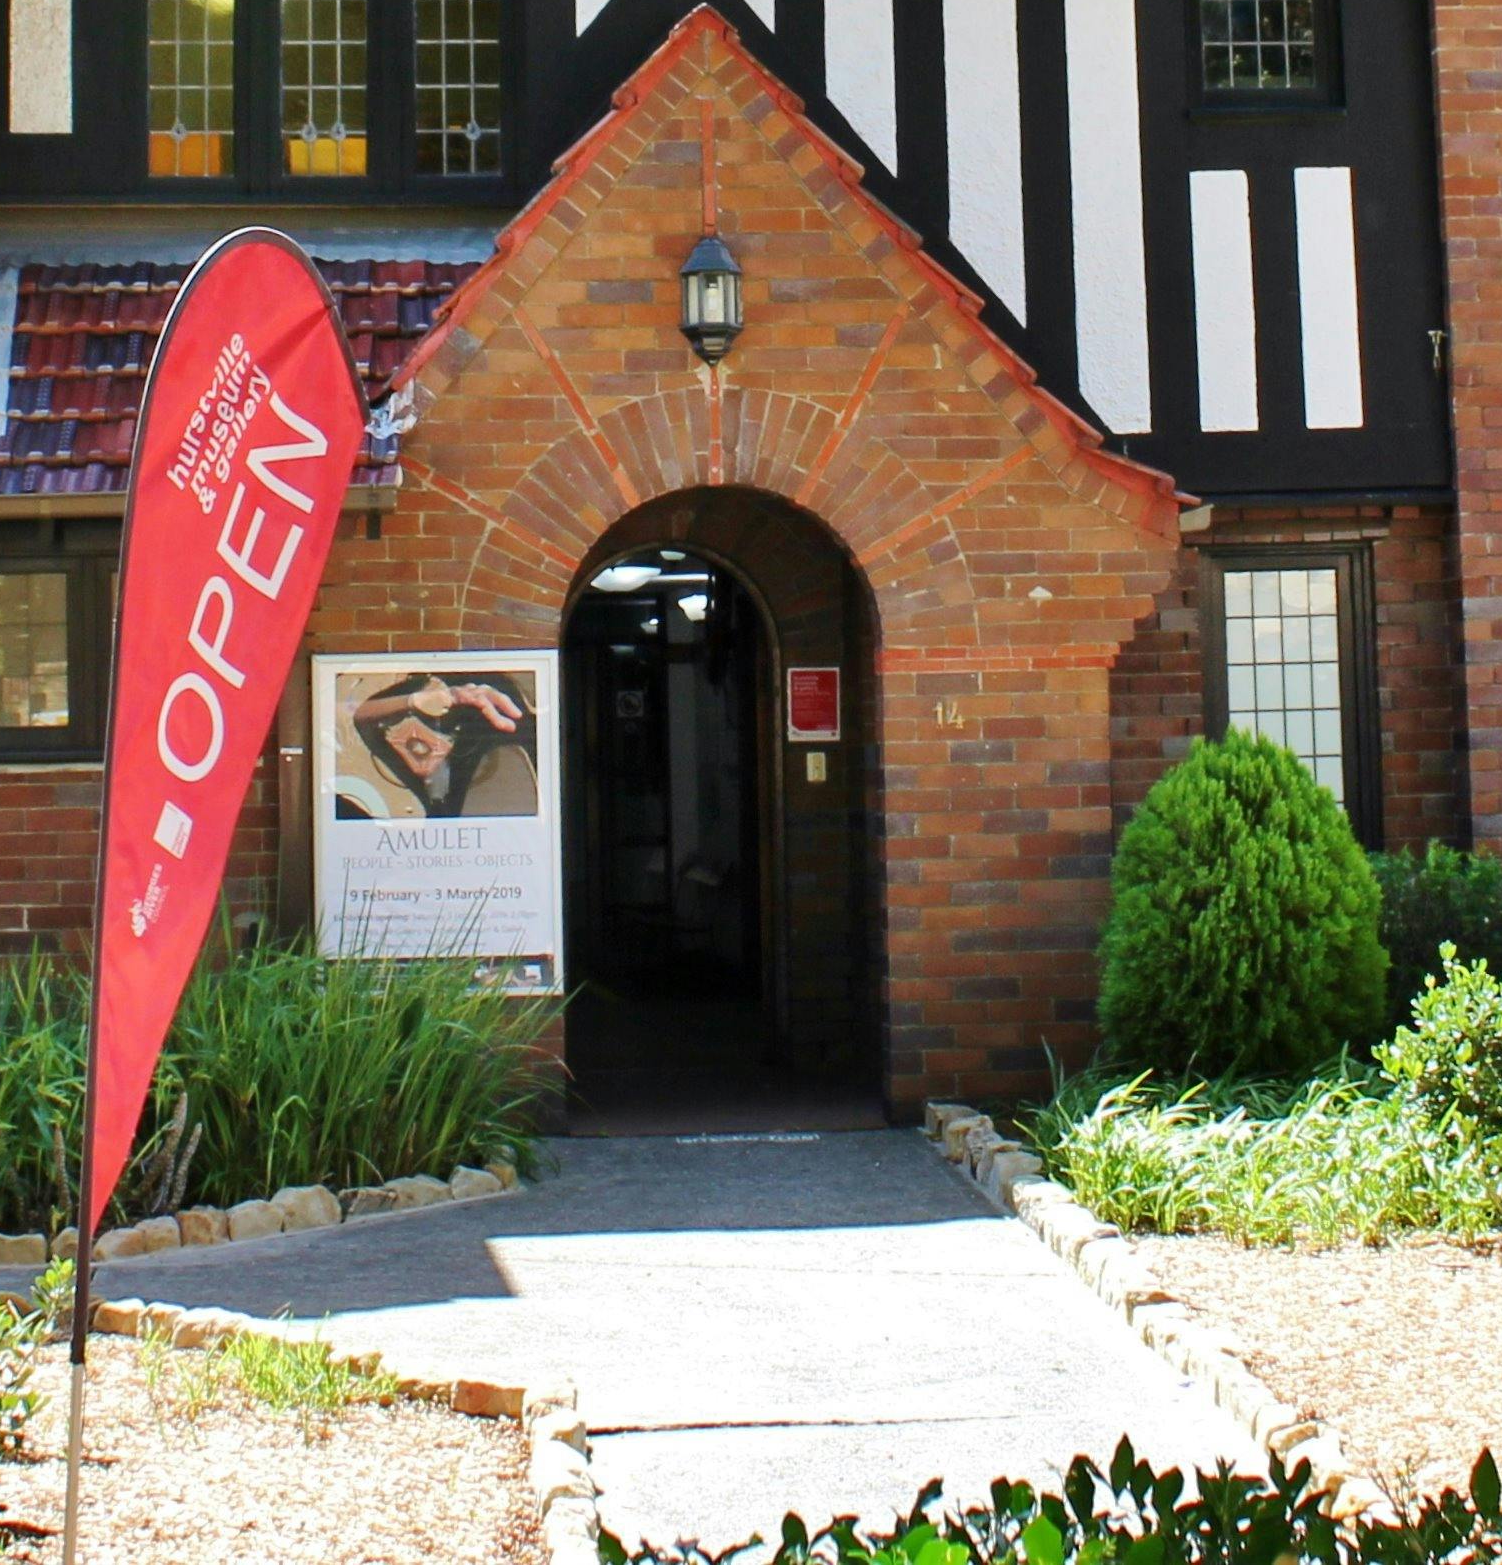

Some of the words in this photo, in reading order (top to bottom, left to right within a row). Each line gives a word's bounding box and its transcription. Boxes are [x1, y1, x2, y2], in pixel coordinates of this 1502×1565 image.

[166, 333, 244, 491] hurstville
[190, 350, 251, 496] museum
[198, 486, 217, 515] &
[215, 364, 272, 484] gallery
[157, 390, 329, 782] OPEN
[932, 701, 965, 730] 14
[342, 856, 393, 870] PEOPLE
[407, 854, 463, 870] STORIES
[474, 853, 534, 869] OBJECTS
[376, 827, 488, 857] AMULET
[349, 890, 358, 902] 9
[363, 889, 421, 904] February
[435, 888, 443, 901] 3
[447, 887, 489, 901] March
[492, 886, 522, 900] 2019
